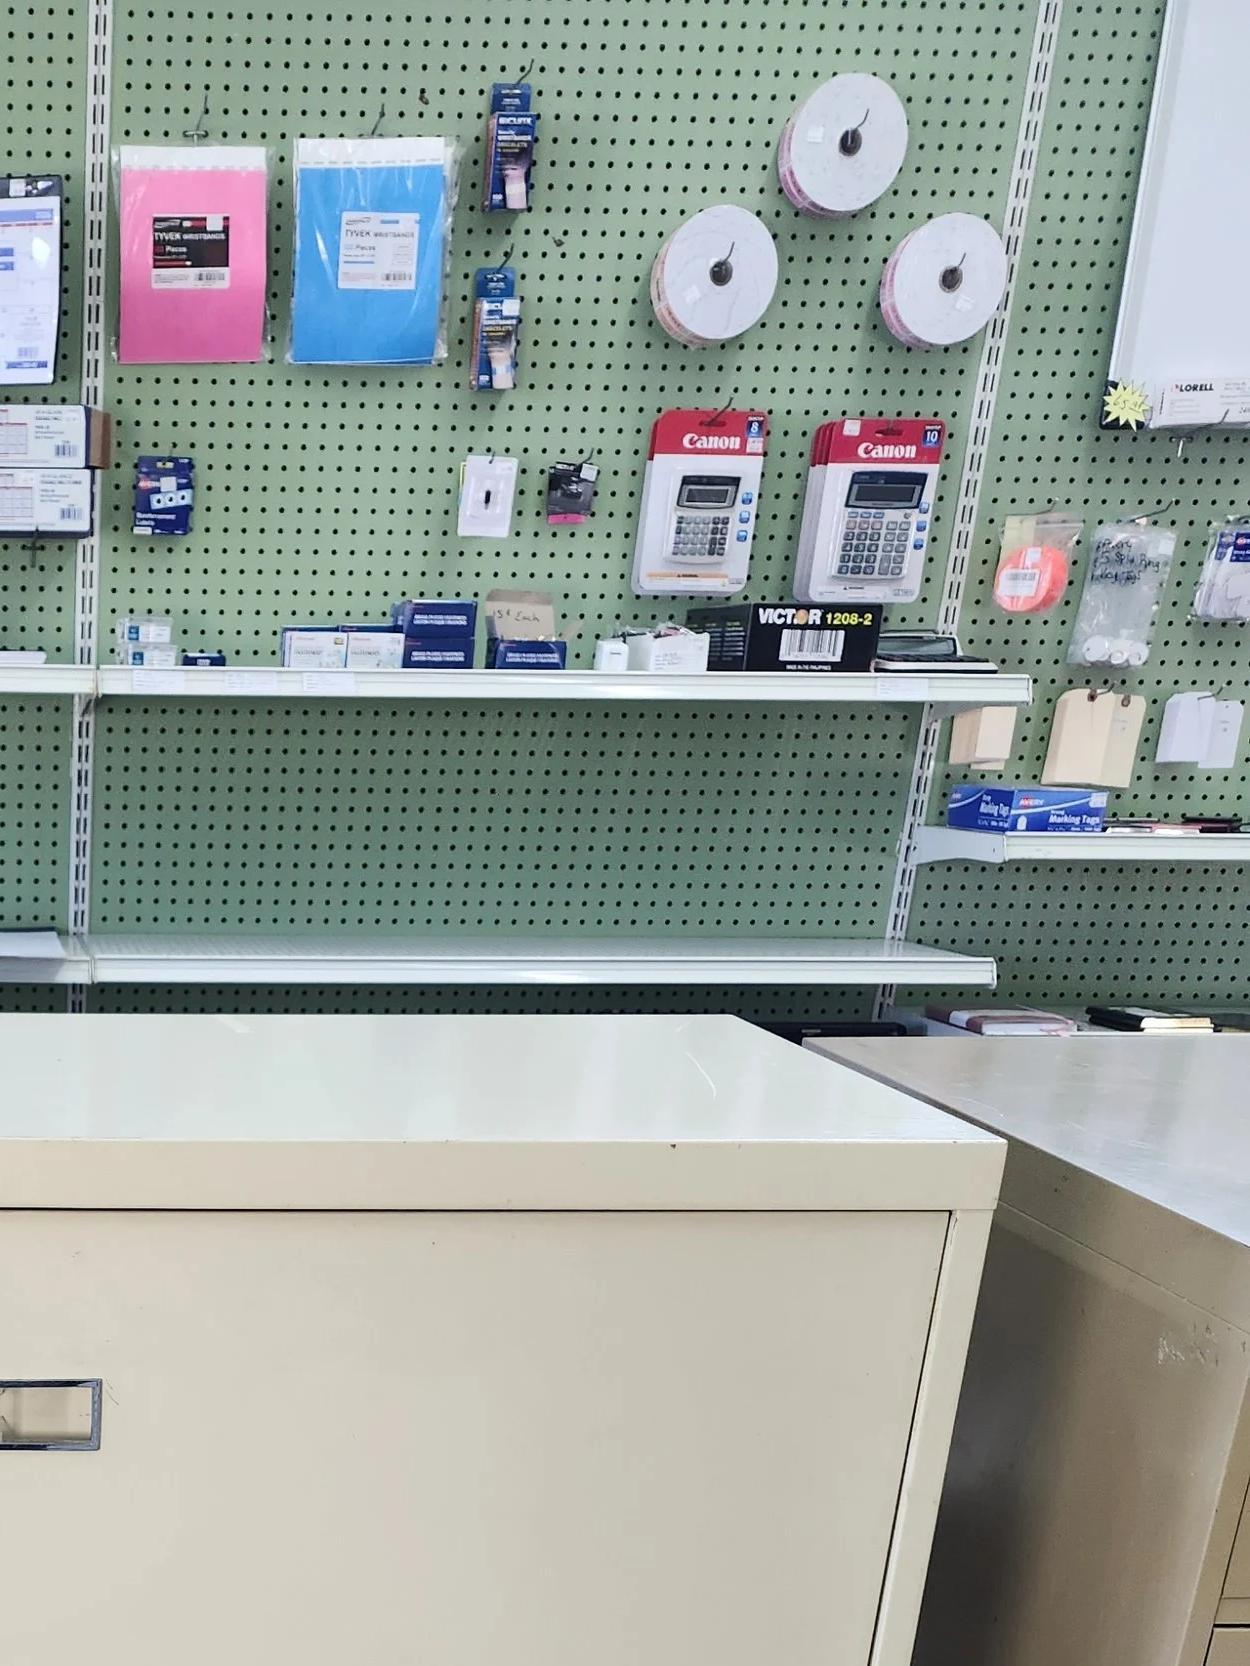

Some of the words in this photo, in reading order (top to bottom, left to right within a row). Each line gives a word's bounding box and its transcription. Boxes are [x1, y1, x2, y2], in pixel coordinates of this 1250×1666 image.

[1179, 383, 1214, 392] LORELL
[750, 421, 760, 434] 8
[682, 433, 741, 449] Canon
[925, 431, 939, 443] 10
[857, 442, 917, 459] Canon
[514, 611, 540, 623] Each
[826, 611, 873, 626] 1208-2
[1018, 797, 1045, 807] AVERY
[979, 802, 999, 816] Marking
[999, 803, 1011, 818] Tags
[1049, 814, 1081, 825] Marking
[1081, 815, 1100, 825] Tags
